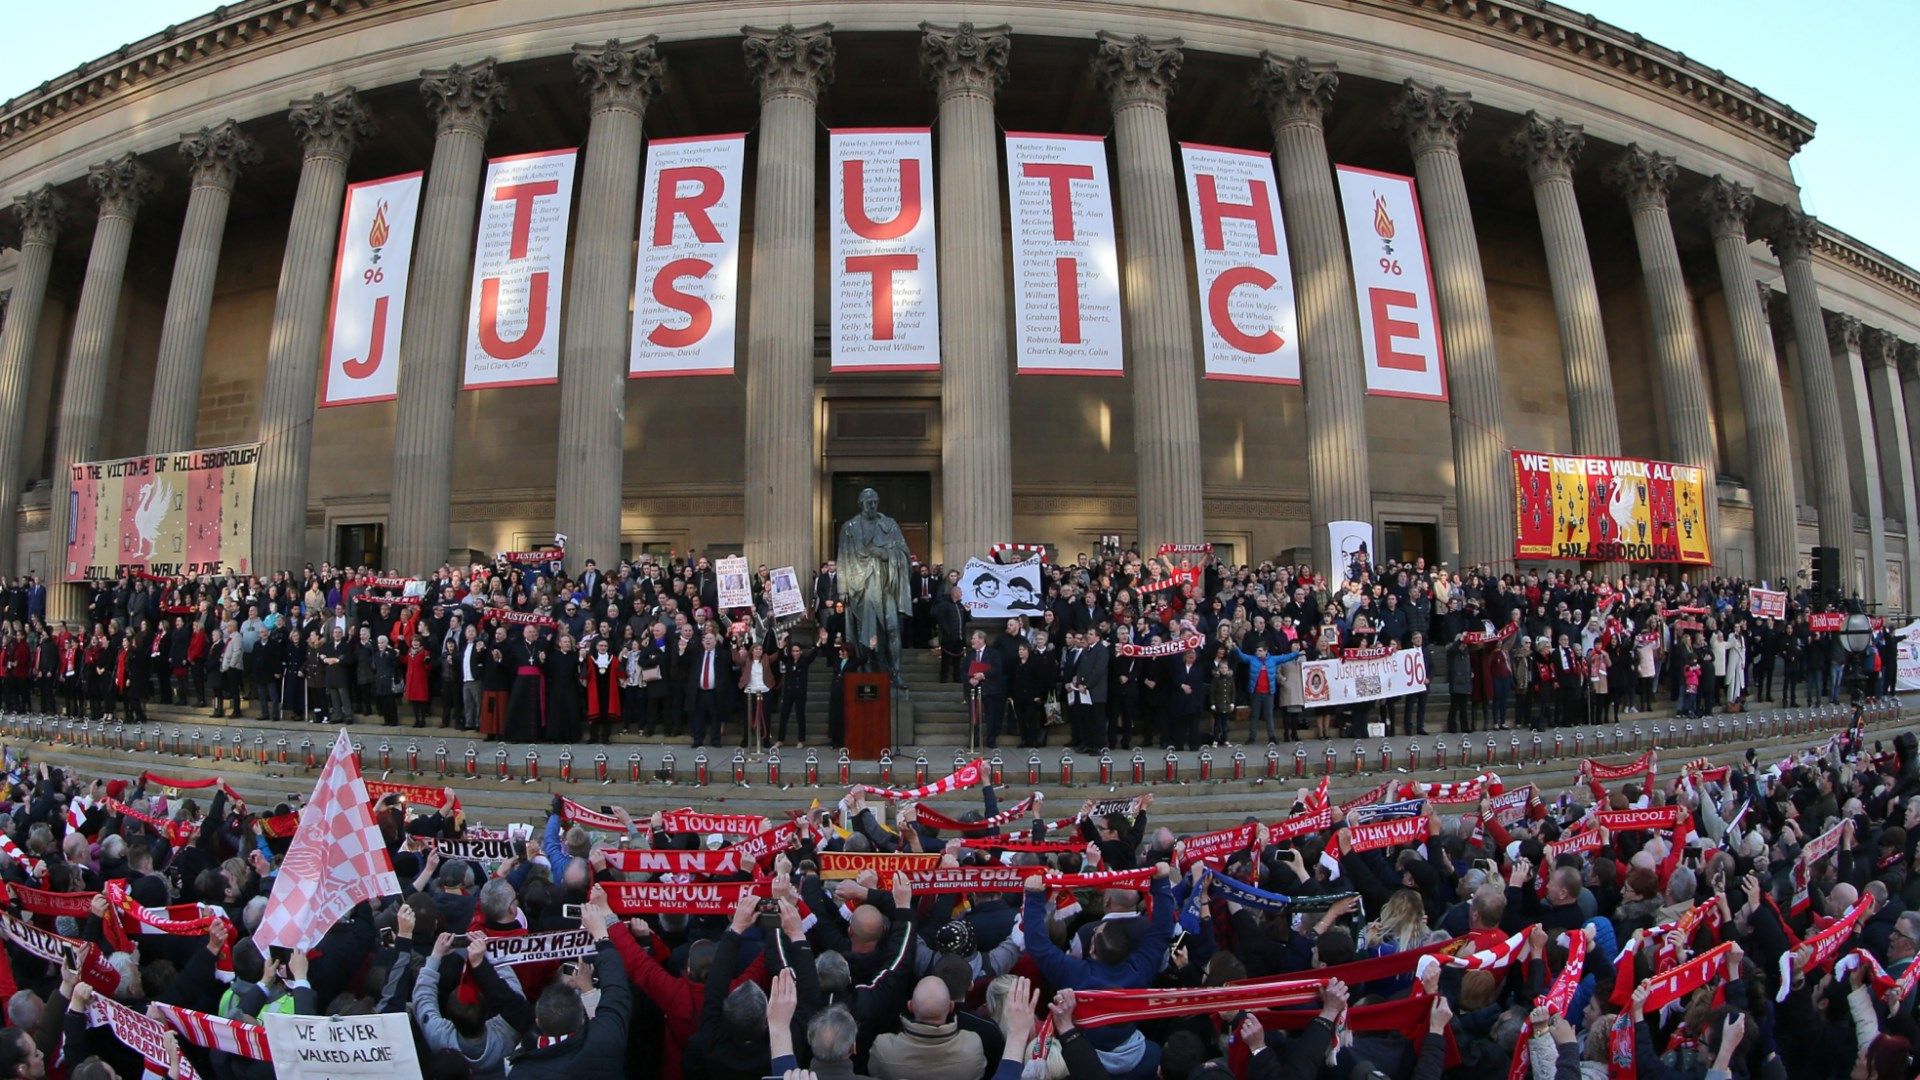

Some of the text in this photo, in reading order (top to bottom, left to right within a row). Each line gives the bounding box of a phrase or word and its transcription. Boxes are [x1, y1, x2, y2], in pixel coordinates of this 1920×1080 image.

[1380, 258, 1402, 276] 96
[364, 268, 384, 285] 96
[1089, 348, 1109, 356] Colin
[73, 449, 260, 480] TO THE VICTIMS OF HILLSBOROUGH
[1520, 455, 1698, 483] WE NEVER WALK ALONE
[516, 552, 545, 560] JUSTICE
[1174, 544, 1205, 552] JUSTICE
[1558, 543, 1677, 561] HILLSBOROUGH
[152, 563, 184, 577] WALK
[189, 561, 223, 576] ALONE
[375, 578, 404, 586] JUSTICE
[503, 611, 538, 622] JUSTICE
[1138, 641, 1186, 655] JUSTICE
[1356, 647, 1386, 657] JUSTICE
[1335, 653, 1425, 686] Justice for the 96
[1602, 810, 1664, 824] VERPOOL
[1351, 821, 1415, 845] LIVERPOOL
[622, 885, 724, 901] LIVERPOOL
[622, 899, 653, 909] YOU'LL
[660, 900, 688, 909] NEVER
[696, 900, 721, 909] WALK
[295, 1025, 379, 1043] WE NEVER
[298, 1046, 392, 1063] WALKED ALONE
